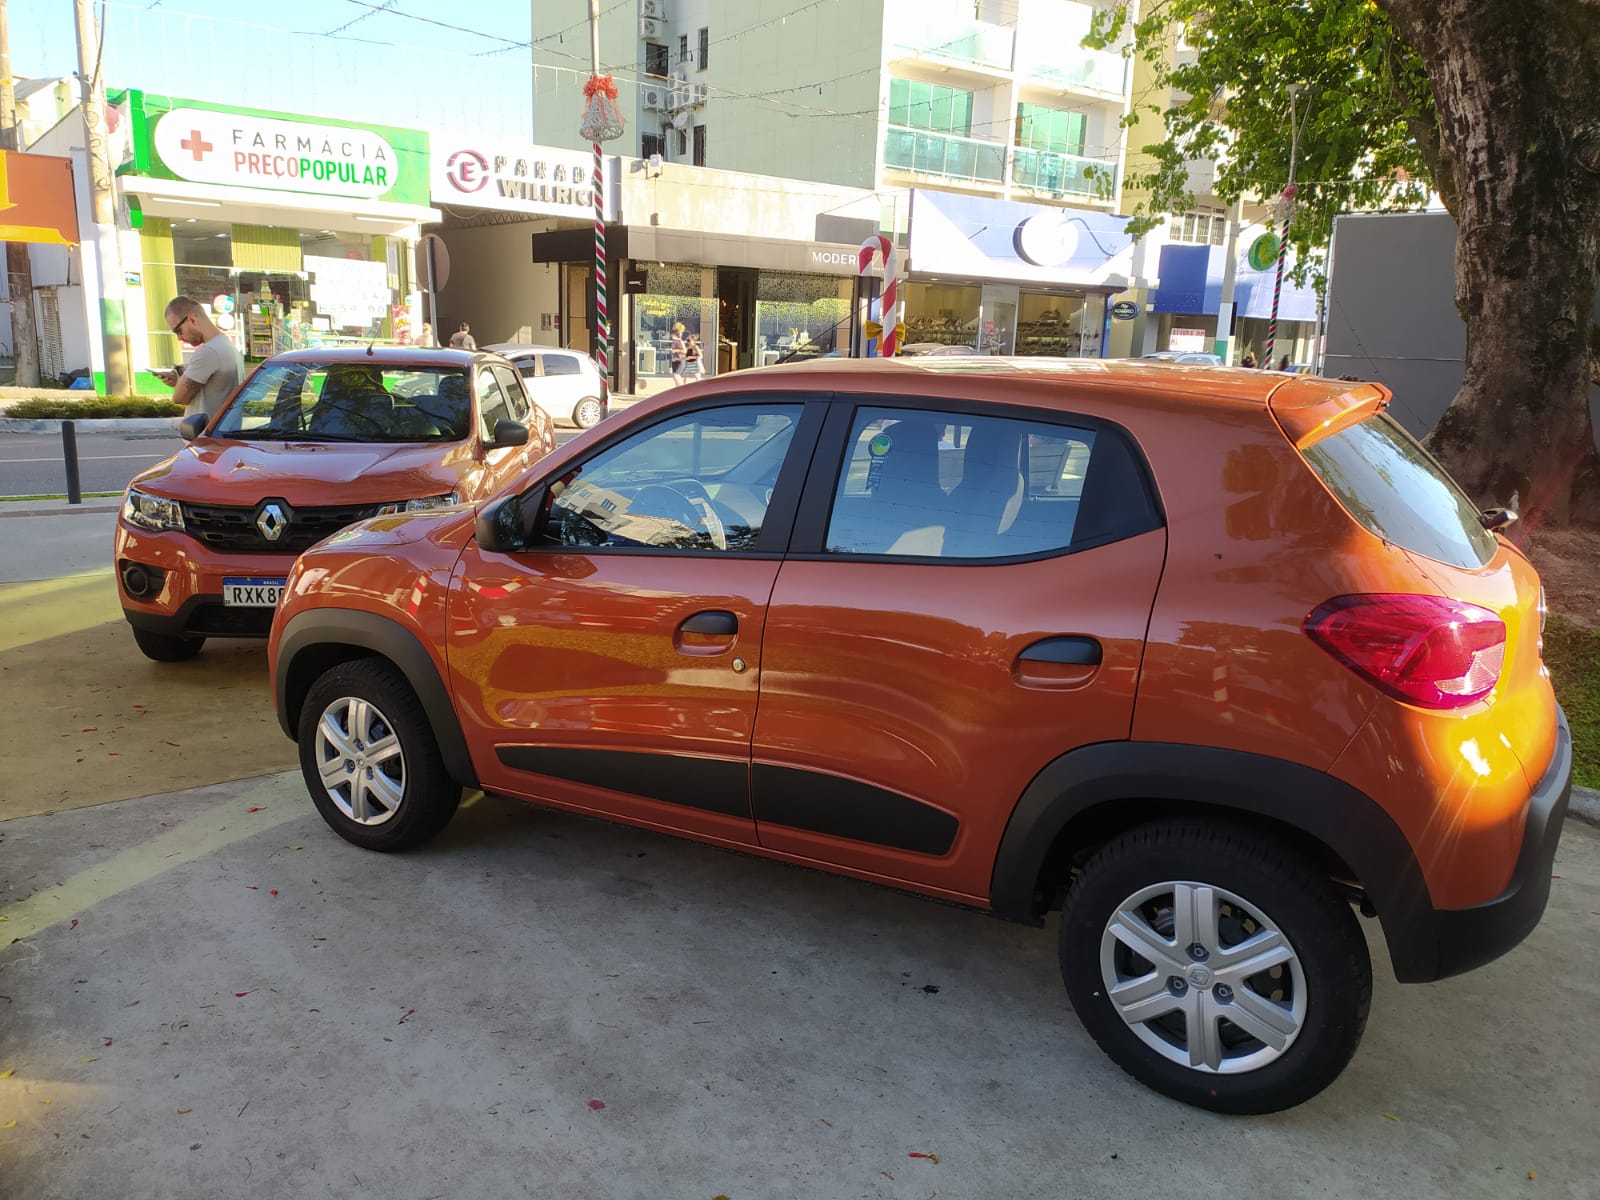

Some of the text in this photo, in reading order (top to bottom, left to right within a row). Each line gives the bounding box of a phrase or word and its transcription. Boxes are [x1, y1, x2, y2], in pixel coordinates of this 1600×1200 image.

[232, 129, 387, 161] FARMÁCIA
[494, 155, 597, 187] PARAD
[812, 251, 859, 266] MODER
